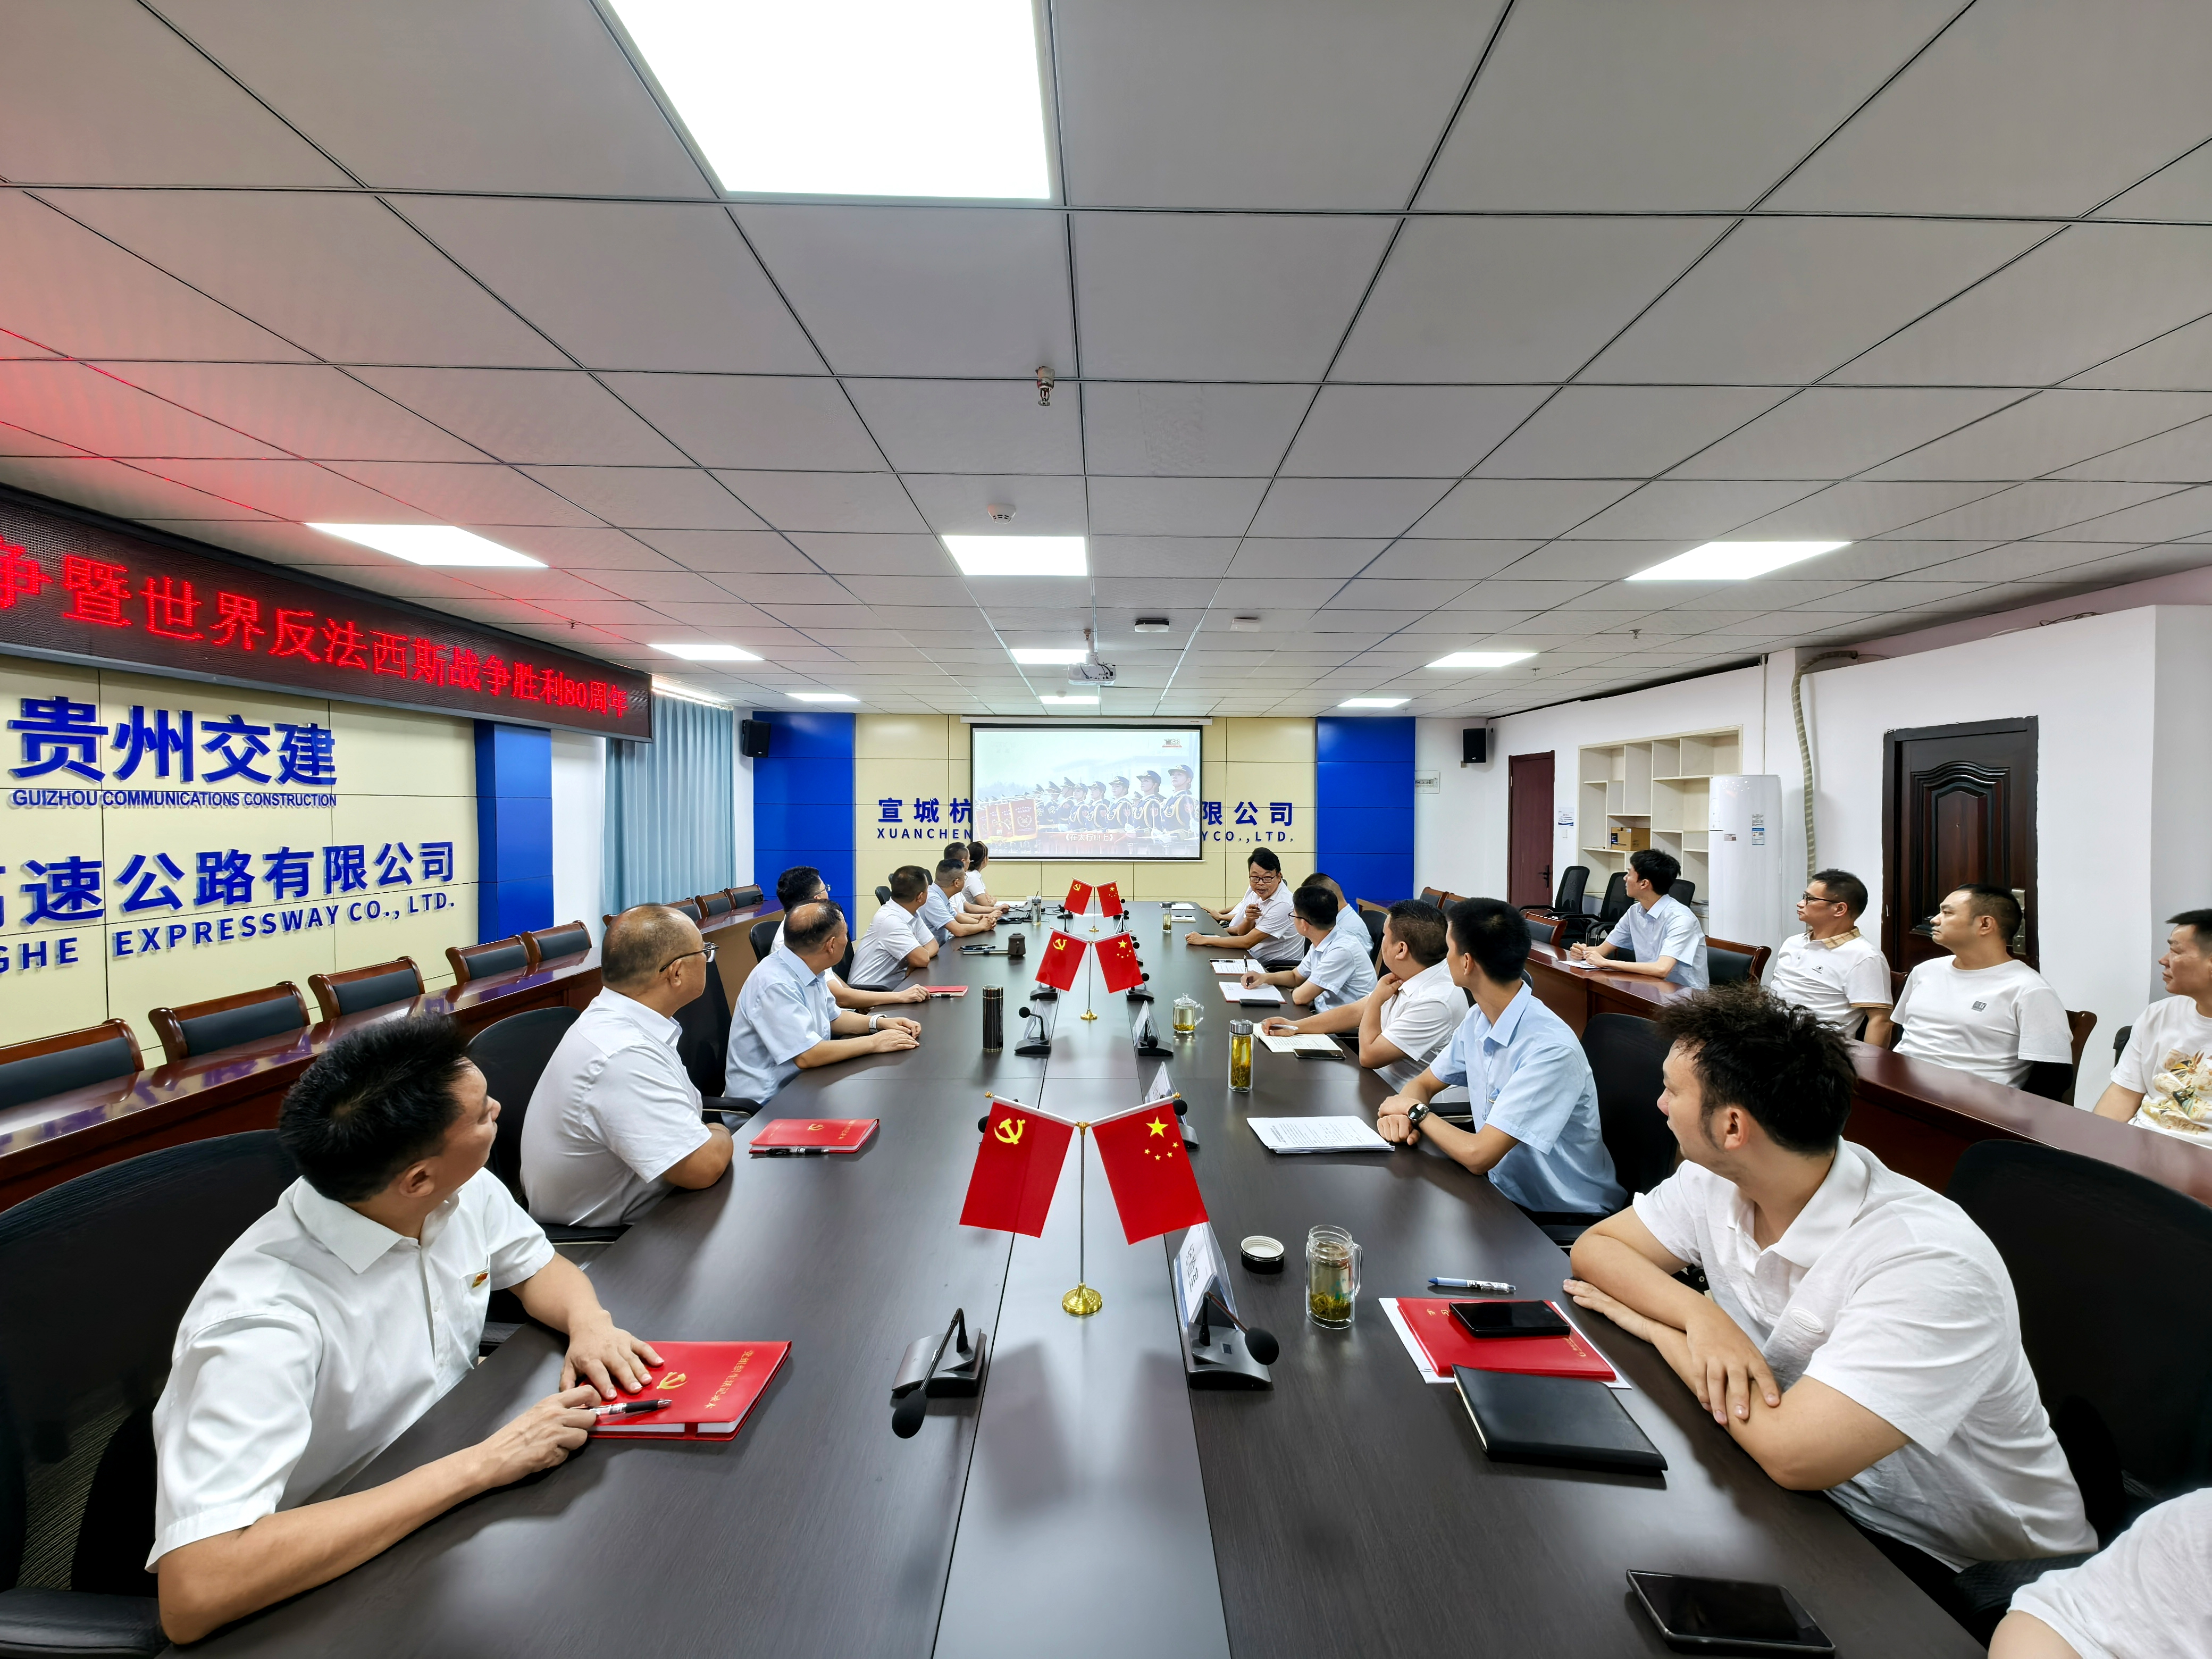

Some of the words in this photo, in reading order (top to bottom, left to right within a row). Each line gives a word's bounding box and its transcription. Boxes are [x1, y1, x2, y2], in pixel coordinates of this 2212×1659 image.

[7, 696, 337, 785] 贵州交建
[13, 790, 97, 806] GUIZHOU
[103, 791, 240, 806] COMMUNICATIONS
[244, 793, 337, 806] CONSTRUCTION
[877, 828, 971, 839] XUANCHEN
[0, 842, 453, 927] 速公路有限公司
[114, 905, 339, 957] EXPRESSWAY
[348, 900, 400, 922] CO.,
[408, 893, 455, 914] LTD.
